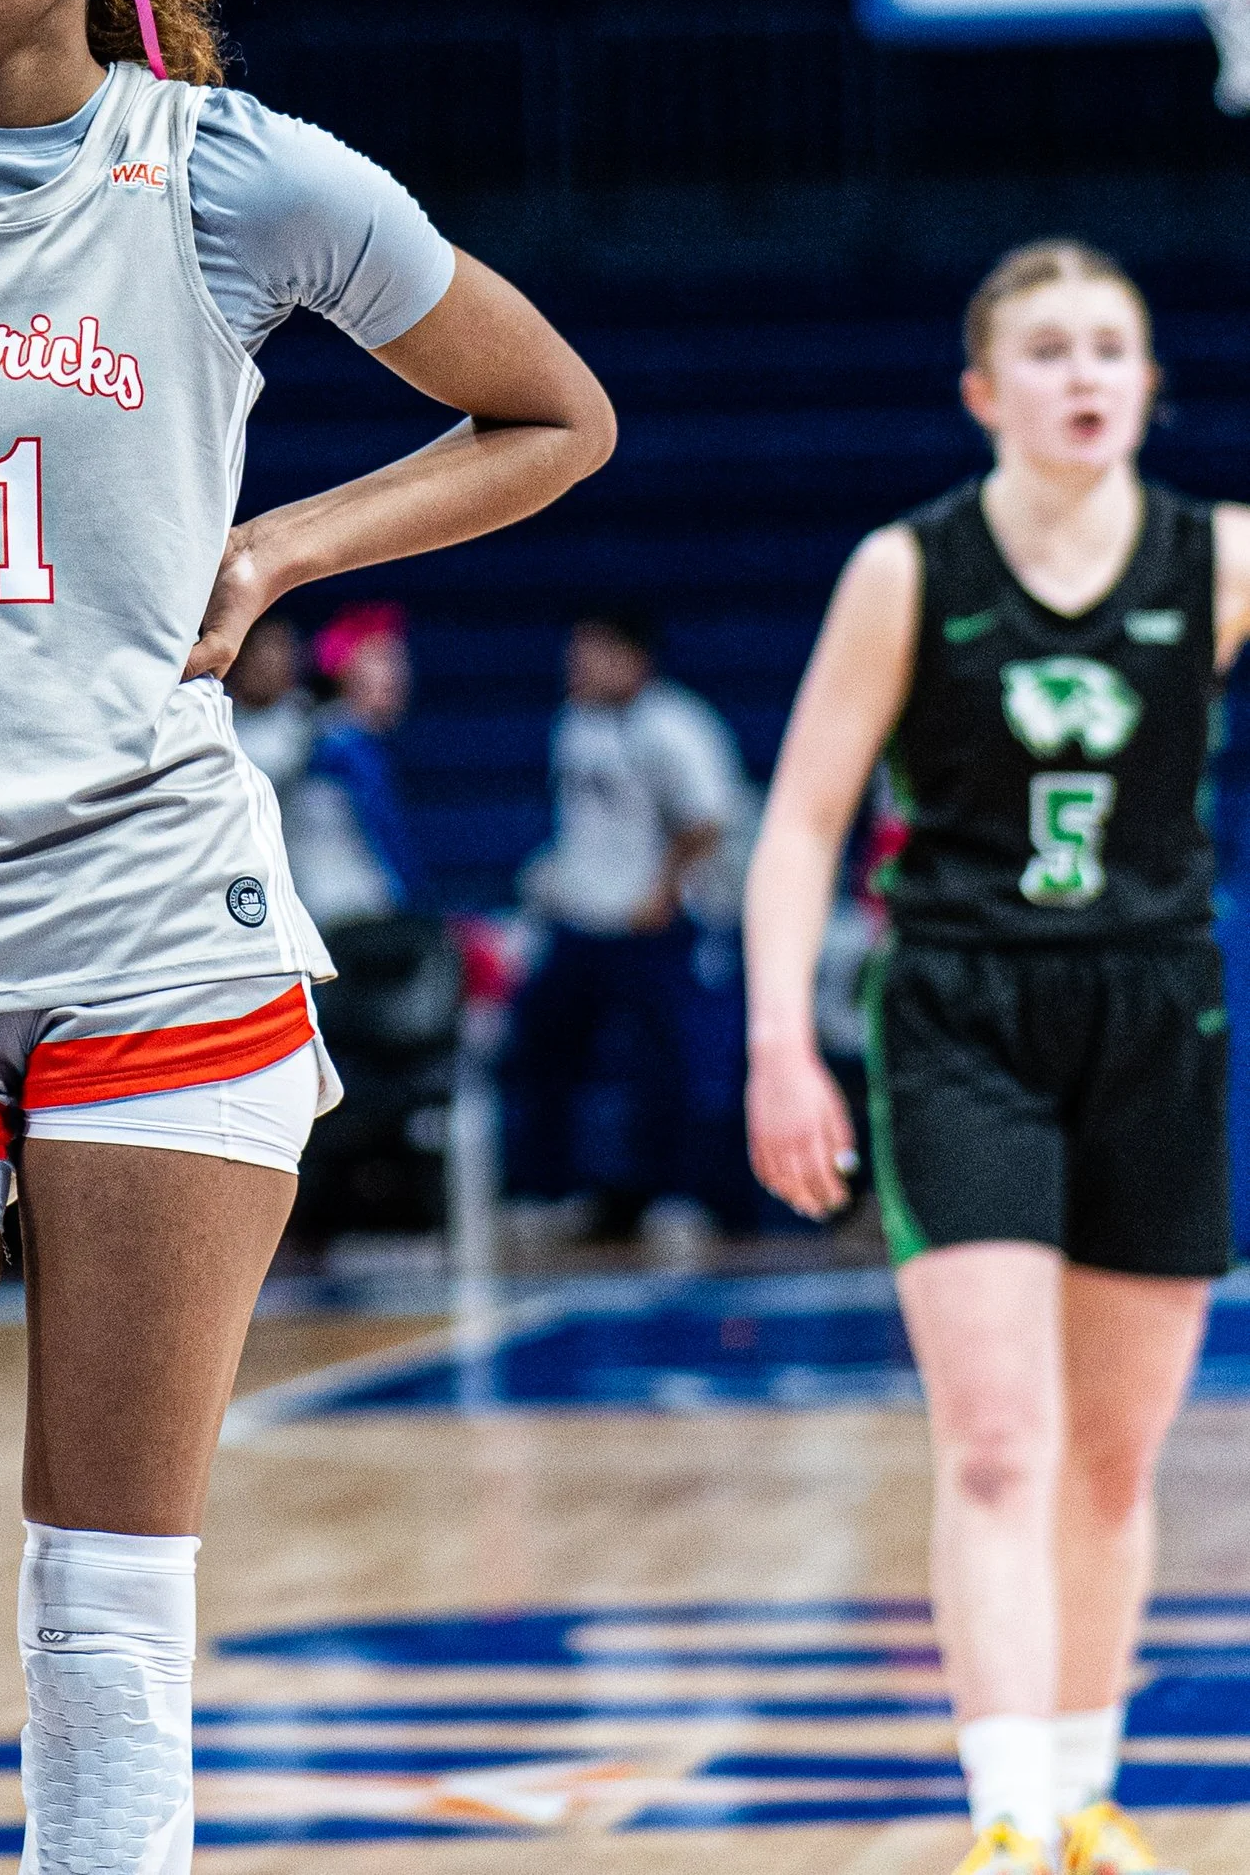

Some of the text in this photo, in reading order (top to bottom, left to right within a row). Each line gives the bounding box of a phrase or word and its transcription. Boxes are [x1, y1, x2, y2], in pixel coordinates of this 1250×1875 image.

[111, 162, 167, 188] WAC
[1018, 771, 1116, 909] 5
[240, 893, 259, 904] SM
